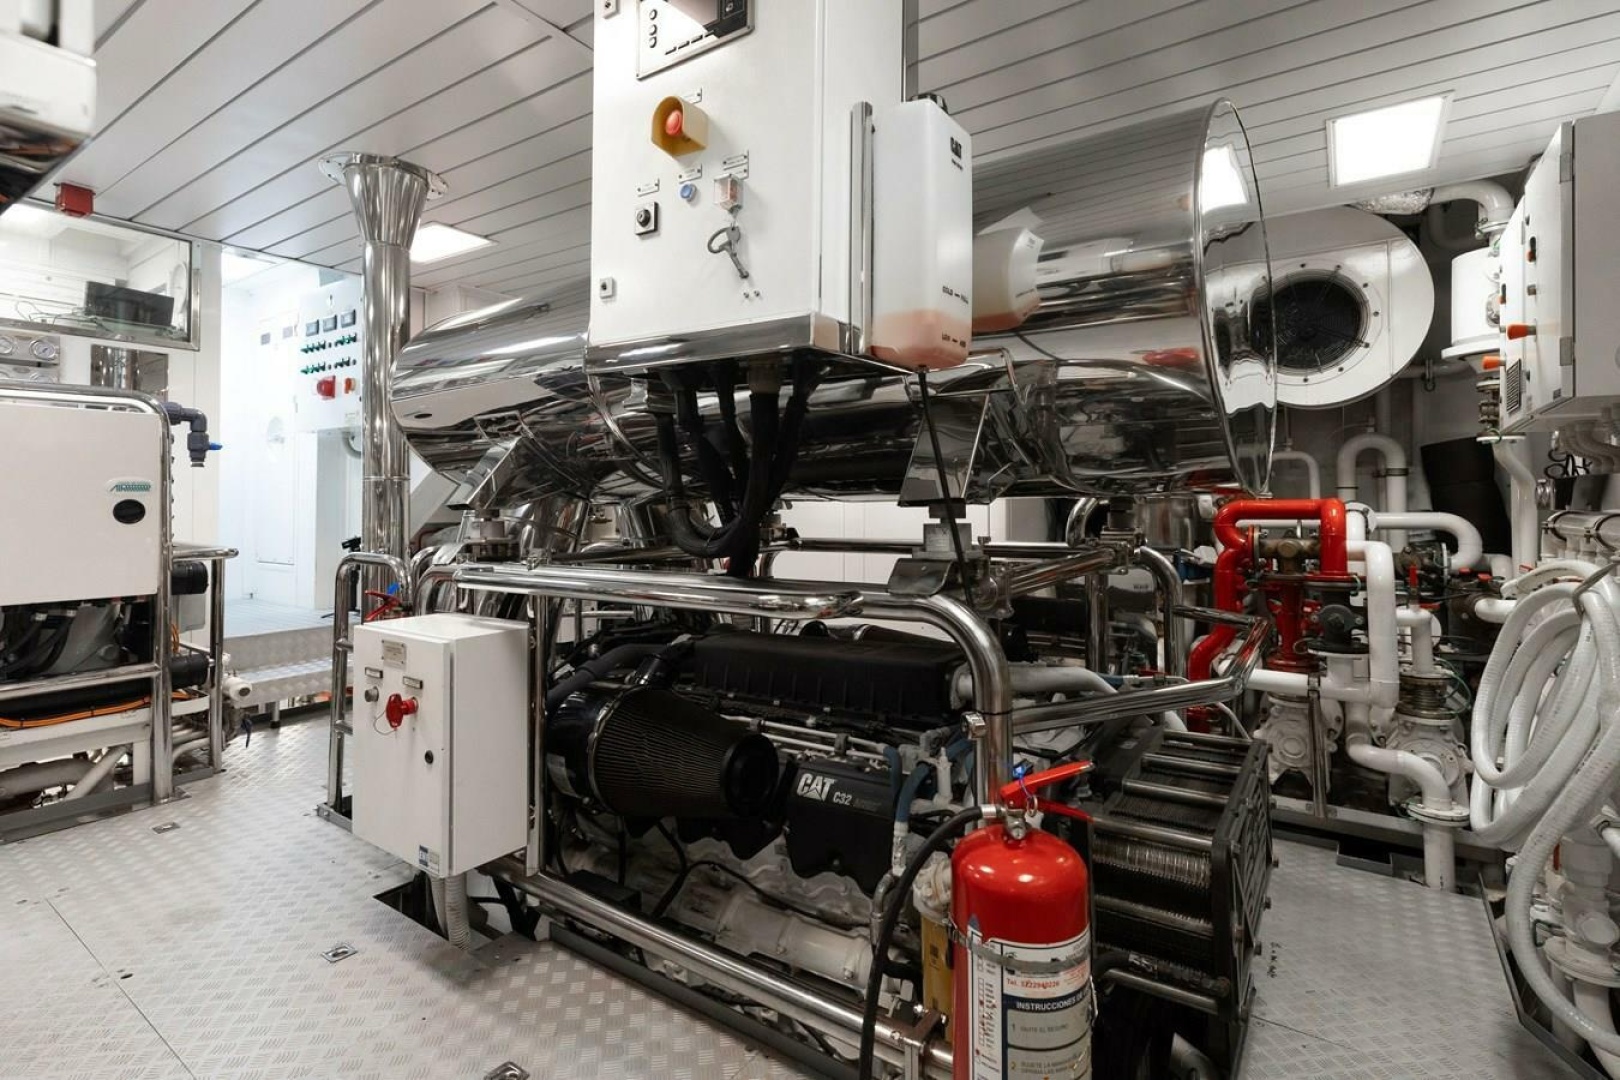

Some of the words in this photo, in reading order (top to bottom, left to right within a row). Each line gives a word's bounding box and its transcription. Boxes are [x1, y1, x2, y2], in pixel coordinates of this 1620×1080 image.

[796, 773, 835, 802] CAT
[833, 791, 853, 806] C32
[1016, 996, 1076, 1011] INSTRUCCIONES
